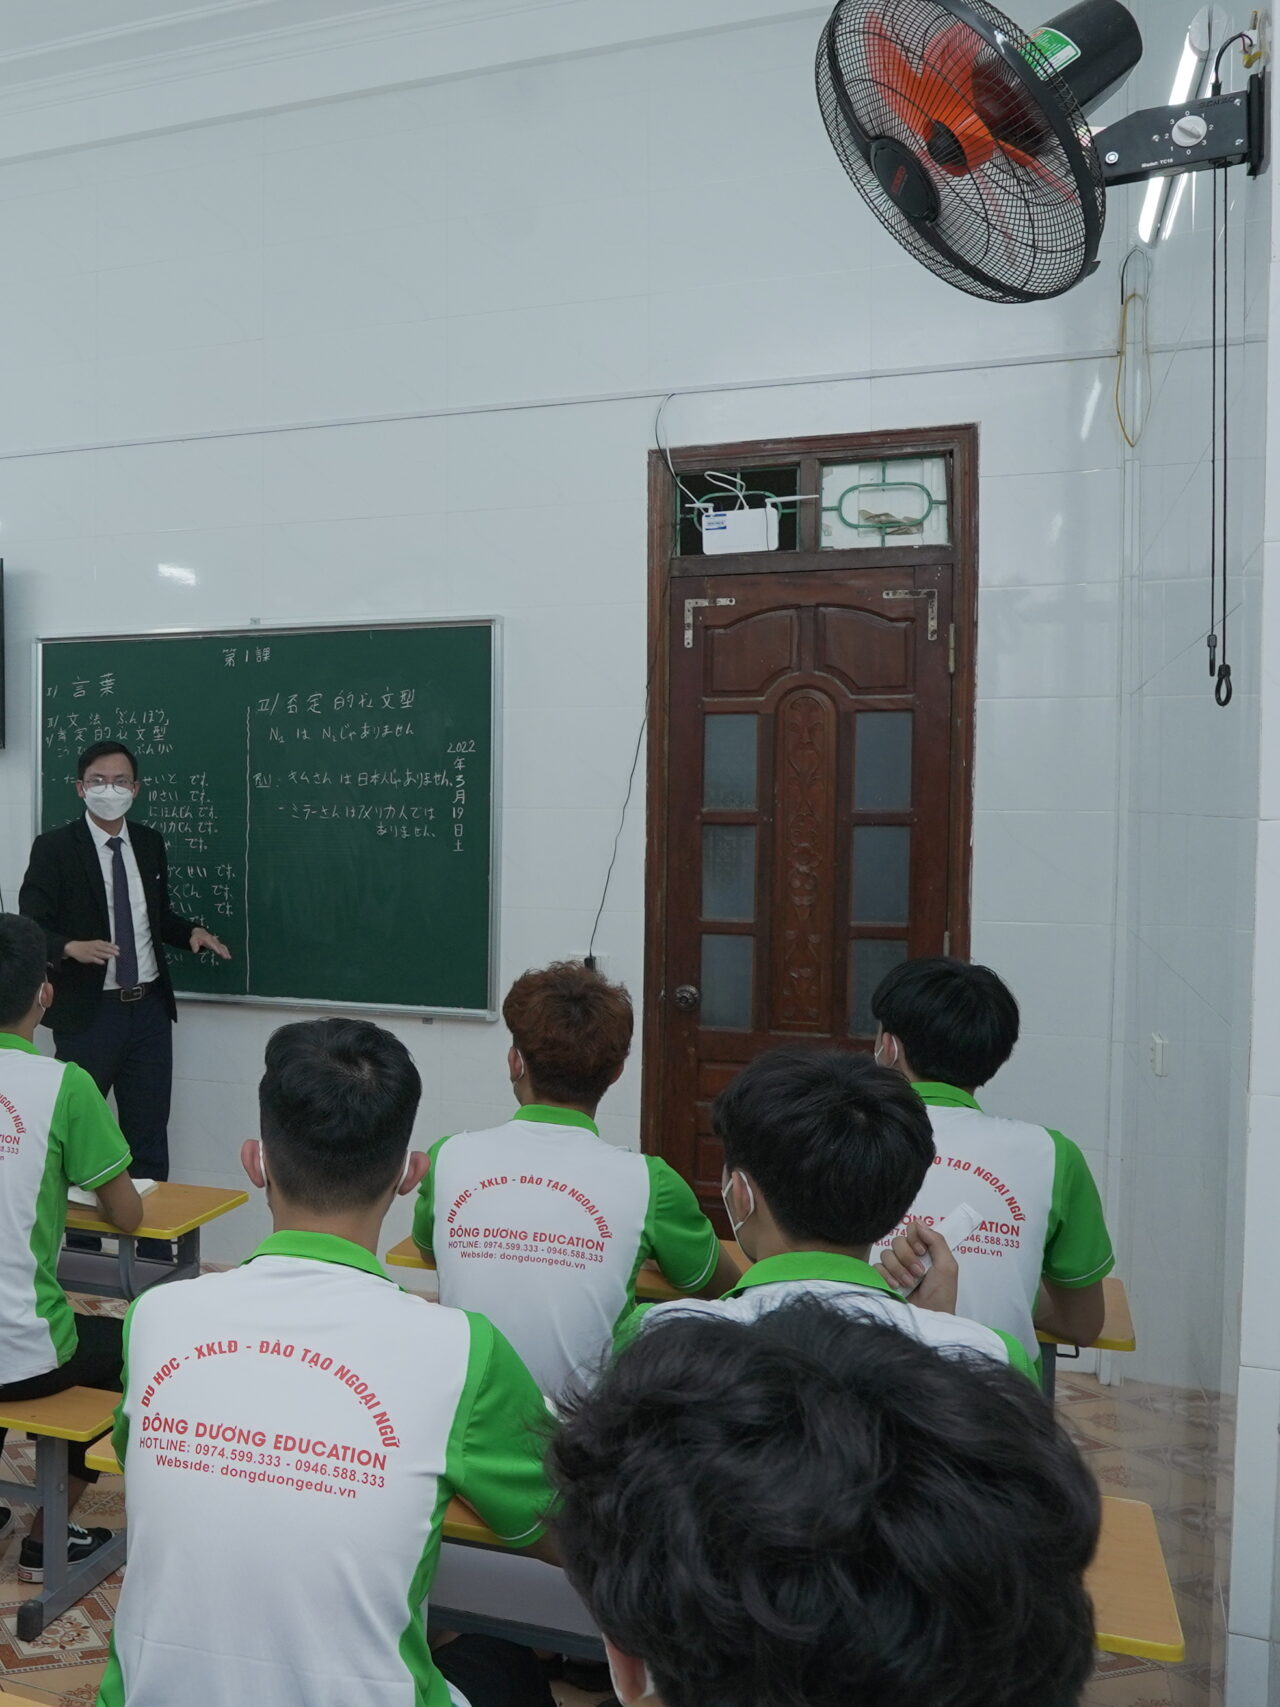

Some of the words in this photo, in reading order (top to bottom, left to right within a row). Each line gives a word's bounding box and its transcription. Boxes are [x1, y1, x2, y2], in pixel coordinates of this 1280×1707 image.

[72, 672, 116, 698] 言葉
[973, 1165, 1011, 1197] NGOẠI
[447, 1209, 458, 1224] DU
[455, 1189, 473, 1209] HỌC
[479, 1176, 508, 1190] XKLĐ
[546, 1179, 568, 1193] TẠO
[567, 1187, 600, 1217] NGOẠI
[483, 1227, 528, 1241] DƯƠNG
[533, 1231, 605, 1252] EDUCATION
[979, 1220, 1020, 1237] ATION
[484, 1240, 538, 1253] 0974.599.333
[546, 1246, 604, 1264] 0946.588.333
[500, 1251, 586, 1270] dongduongedu.vn
[141, 1384, 155, 1408] DU
[153, 1357, 181, 1385] HỌC
[194, 1340, 238, 1360] XKLĐ
[259, 1339, 295, 1358] ĐÀO
[300, 1348, 334, 1371] TẠO
[333, 1364, 382, 1411] NGOẠI
[372, 1410, 400, 1448] NGỮ
[142, 1412, 189, 1435] ĐÔNG
[195, 1422, 266, 1448] DƯƠNG
[273, 1433, 388, 1471] EDUCATION
[139, 1437, 190, 1453] HOTLINE:
[195, 1443, 281, 1468] 0974.599.333
[295, 1459, 385, 1488] 0946.588.333
[156, 1454, 215, 1473] Webside:
[220, 1465, 357, 1499] dongduongedu.vn
